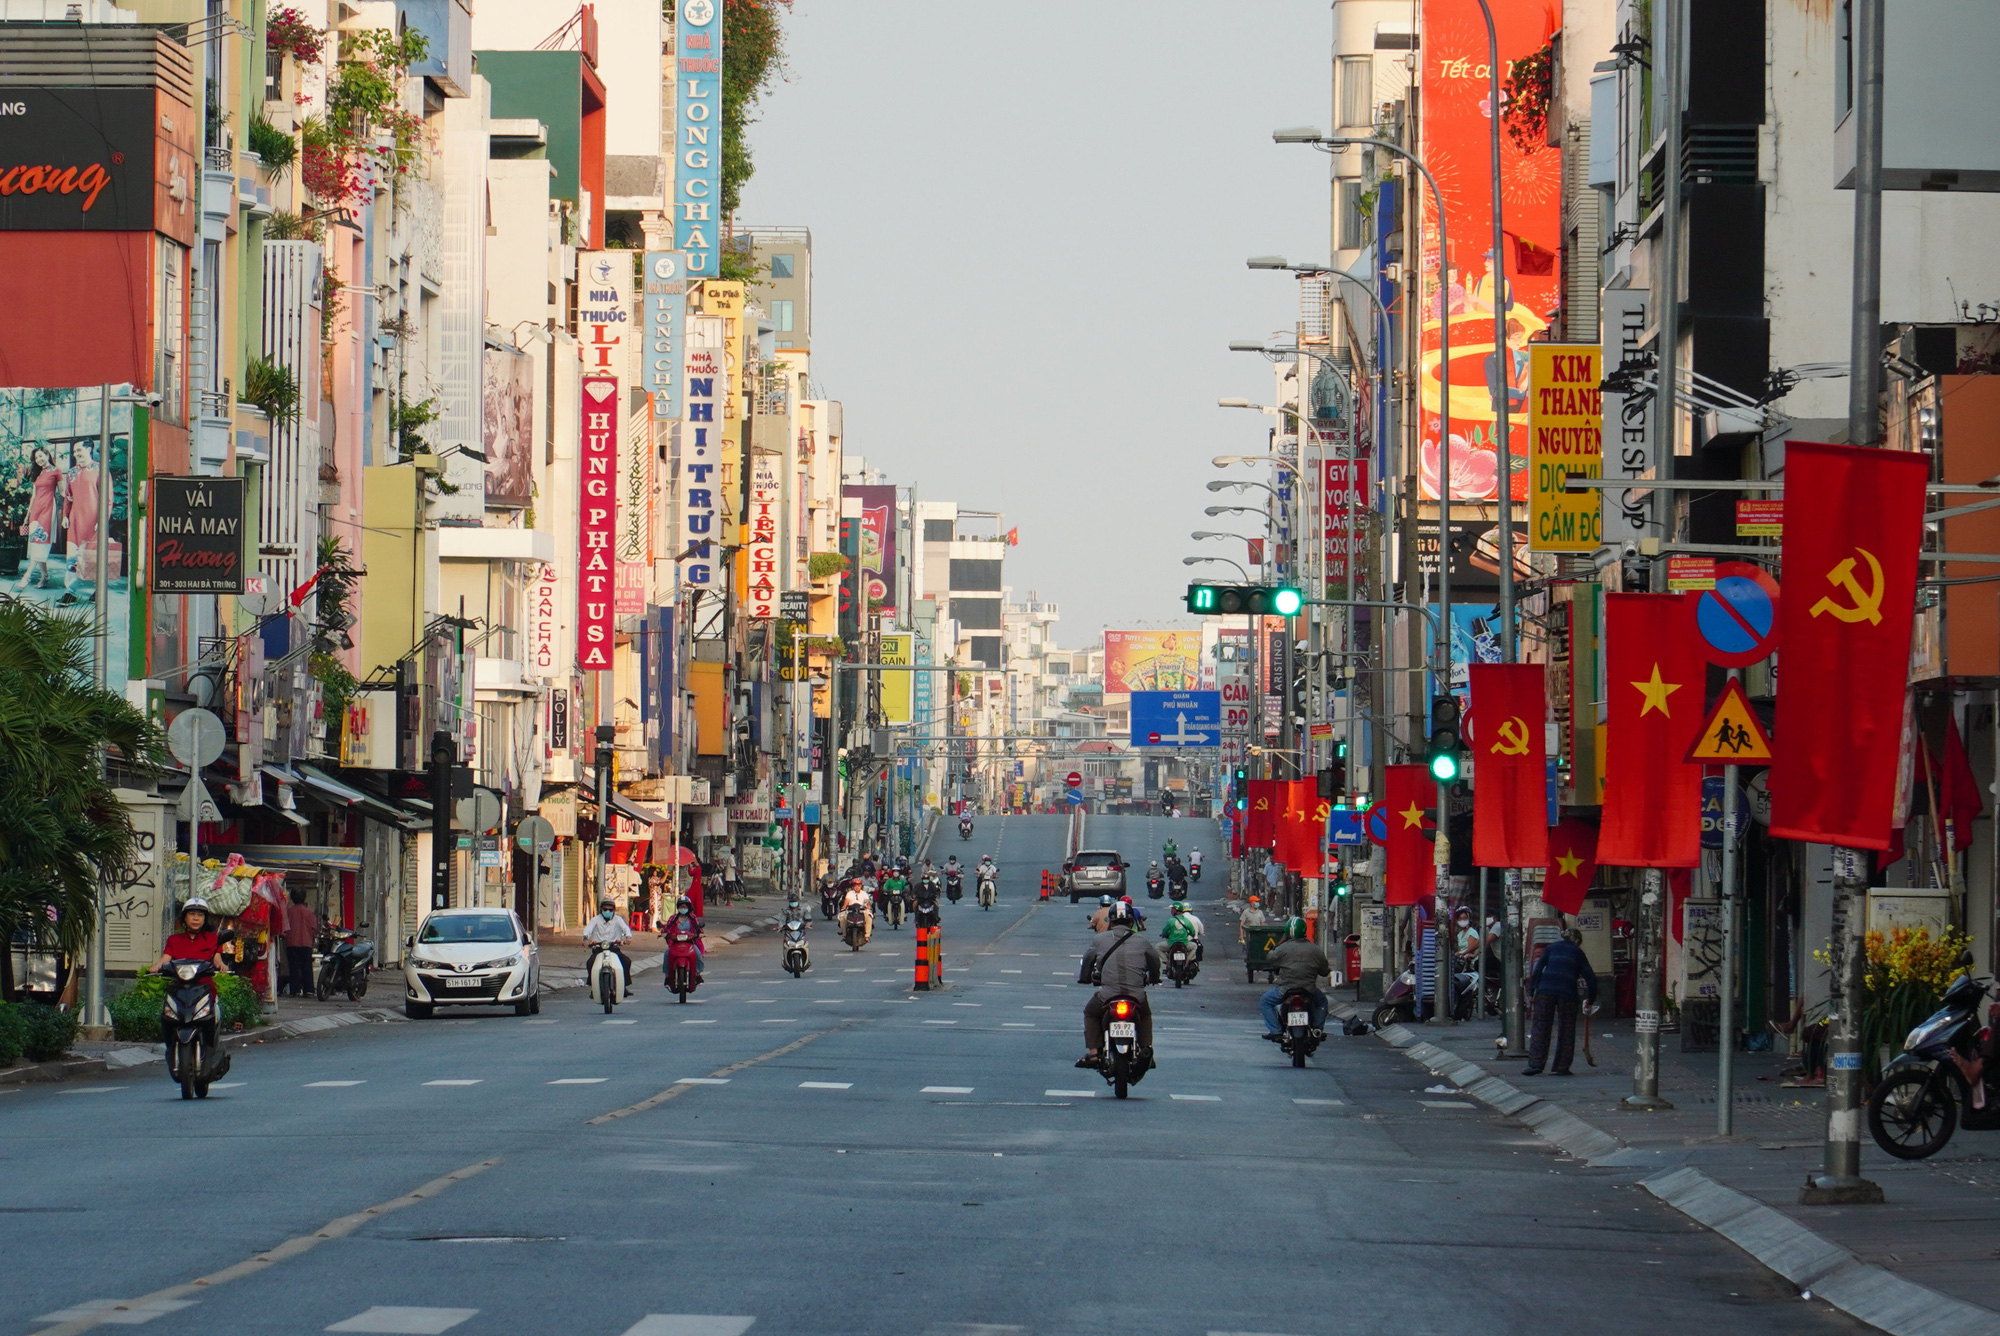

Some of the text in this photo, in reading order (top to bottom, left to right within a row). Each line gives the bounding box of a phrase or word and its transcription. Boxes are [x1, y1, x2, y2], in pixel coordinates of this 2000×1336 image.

[685, 34, 711, 50] NHÀ
[679, 52, 719, 73] THUỐC
[1440, 57, 1470, 78] Tết
[682, 80, 711, 272] LONG CHÂU
[590, 287, 619, 302] NHÀ
[581, 305, 627, 323] THUỐC
[654, 298, 673, 353] LONG
[691, 351, 712, 361] NHÀ
[685, 364, 719, 374] THUỐC
[1552, 355, 1592, 383] KIM
[689, 377, 714, 456] NHỊ
[185, 482, 213, 507] VẢI
[159, 511, 238, 535] NHÀ MAY
[1539, 504, 1574, 542] CẦM
[585, 413, 611, 664] HƯNG PHÁT USA
[201, 578, 210, 588] BÀ
[212, 580, 236, 589] TRƯNG
[755, 605, 772, 616] 2
[781, 601, 808, 610] BEAUTY
[537, 622, 552, 667] CHÂU
[1273, 639, 1283, 691] ARISTINO
[1162, 700, 1198, 709] PHÚ NHUẬN
